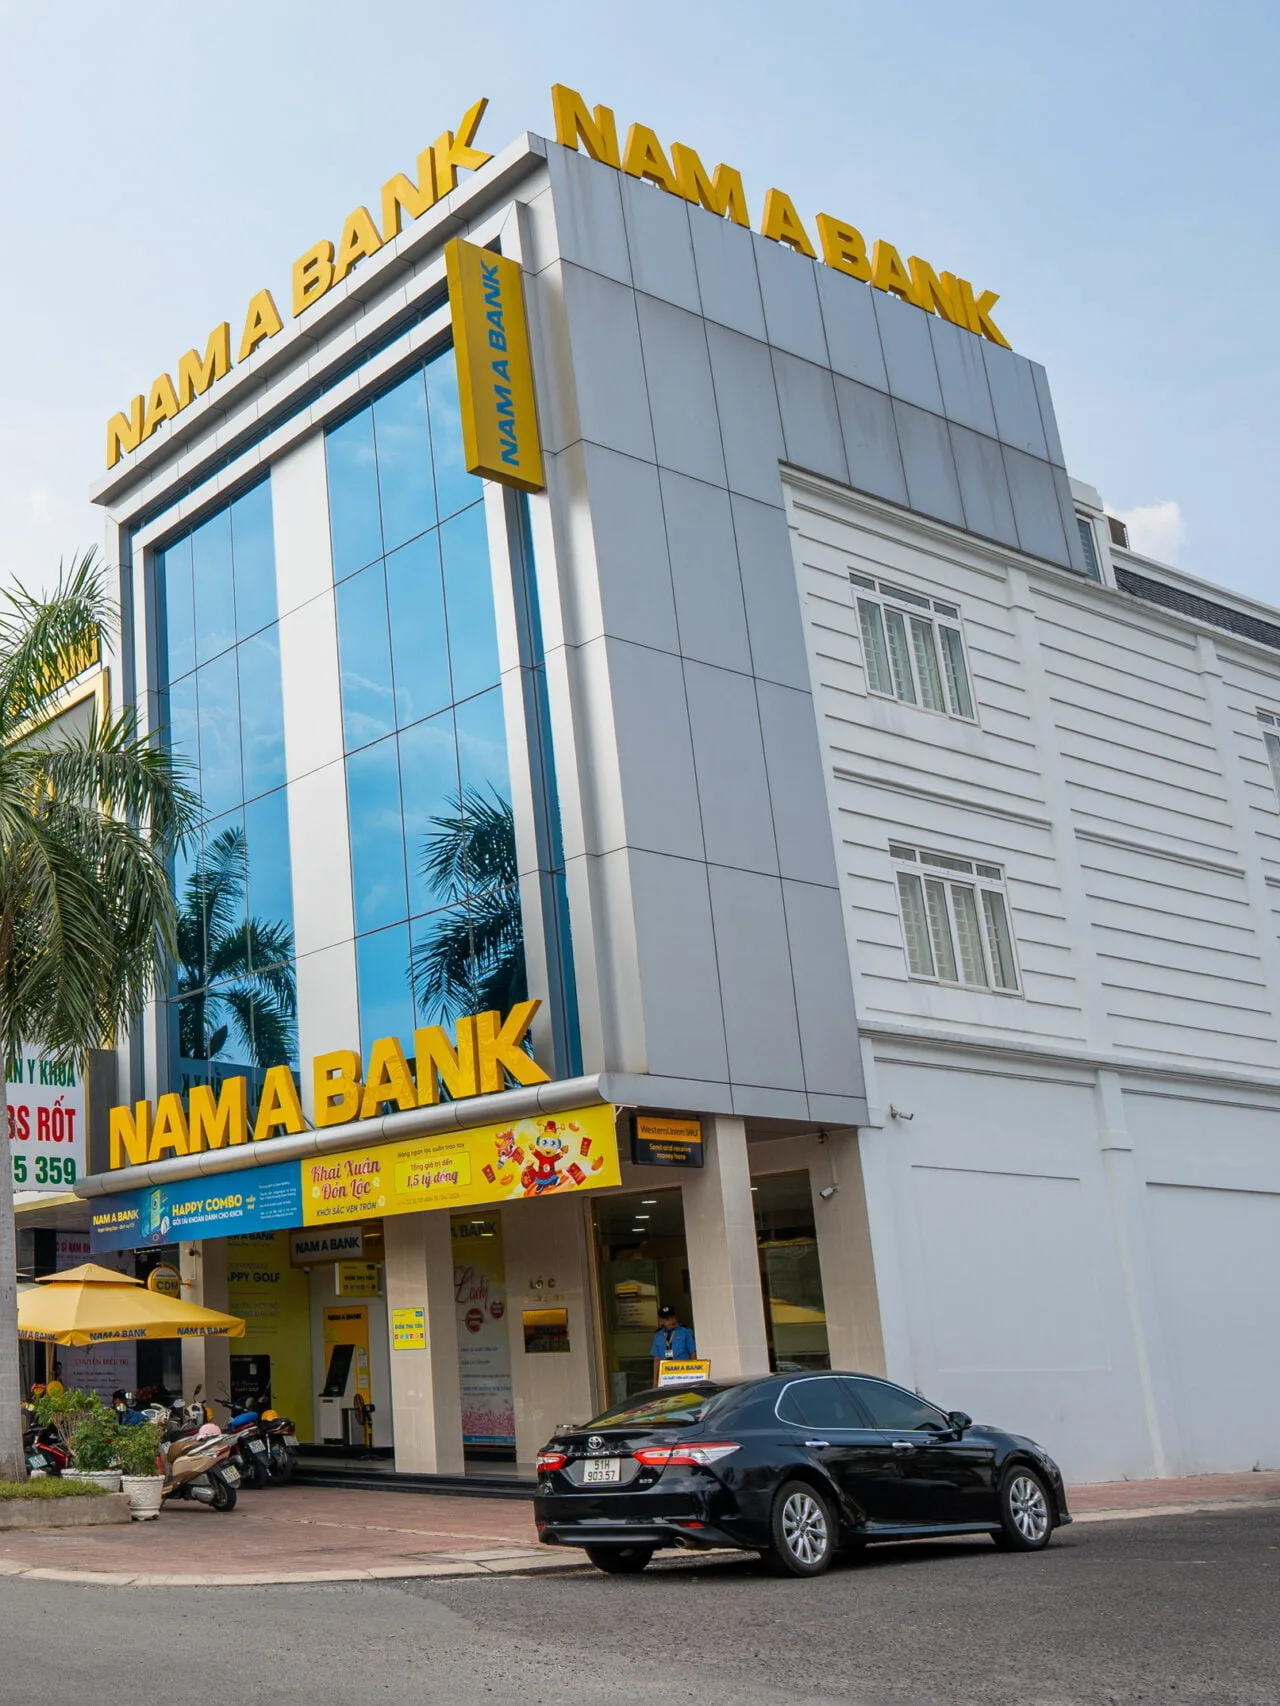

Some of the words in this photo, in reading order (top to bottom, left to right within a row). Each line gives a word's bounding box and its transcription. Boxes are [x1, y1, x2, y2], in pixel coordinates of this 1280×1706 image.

[551, 83, 750, 227] NAM
[761, 188, 817, 259] A
[813, 212, 1013, 350] BANK
[107, 321, 230, 468] NAM
[238, 289, 283, 362] A
[293, 97, 493, 317] BANK
[480, 258, 510, 352] BANK
[494, 359, 513, 384] A
[497, 393, 521, 467] NAM
[110, 1076, 247, 1169] NAM
[253, 1065, 306, 1141] A
[313, 999, 551, 1128] BANK
[37, 1095, 76, 1143] RỐT
[35, 1156, 76, 1185] 359
[311, 1163, 341, 1183] Khai
[344, 1157, 381, 1175] Xuân
[433, 1169, 458, 1184] đồng
[321, 1181, 347, 1200] Đón
[351, 1178, 371, 1199] Lộc
[172, 1201, 203, 1216] HAPPY
[205, 1195, 242, 1211] COMBO
[332, 1204, 344, 1215] SẮC
[360, 1201, 376, 1211] TRÒN
[93, 1213, 110, 1225] NAM
[111, 1212, 117, 1222] A
[118, 1209, 139, 1221] BANK
[460, 1222, 496, 1237] BANK
[296, 1240, 319, 1254] NAM
[321, 1239, 328, 1251] A
[330, 1236, 360, 1250] BANK
[253, 1272, 280, 1282] GOLF
[90, 1332, 110, 1340] NAM
[122, 1328, 146, 1337] BANK
[177, 1327, 197, 1335] NAM
[587, 1470, 615, 1481] 903.57
[595, 1460, 610, 1470] 51H
